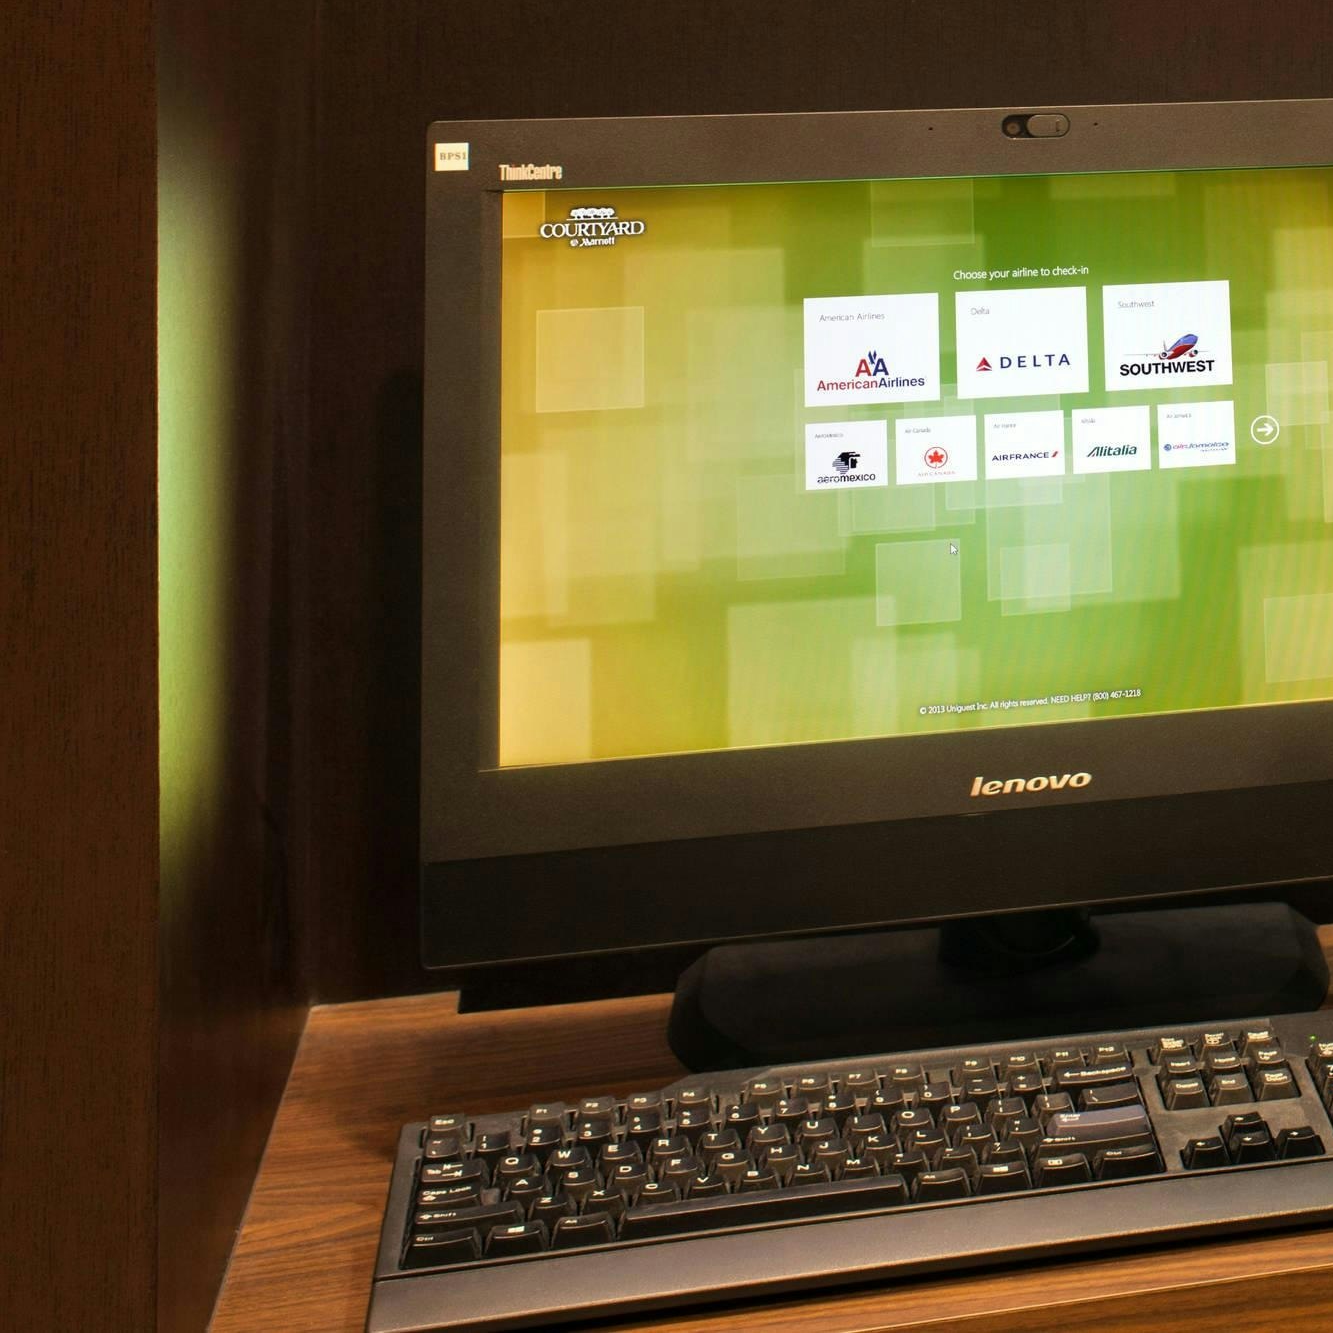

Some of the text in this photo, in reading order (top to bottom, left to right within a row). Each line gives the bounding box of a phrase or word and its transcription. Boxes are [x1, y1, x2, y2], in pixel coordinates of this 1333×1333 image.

[439, 152, 467, 161] BPS1
[499, 164, 563, 181] ThinkCentre
[540, 220, 645, 239] COURTYARD
[579, 236, 616, 247] Marriott
[953, 265, 1089, 281] Choose your airline to check-in
[1117, 300, 1155, 309] Southwest
[970, 307, 990, 315] Delta
[819, 312, 885, 323] American Airlines
[1000, 353, 1070, 369] DELTA
[1120, 360, 1215, 376] SOUTHWEST
[1087, 444, 1137, 457] Alitalia
[817, 473, 876, 484] aeromexico
[928, 705, 945, 714] 2013
[1000, 700, 1019, 709] rights
[1050, 695, 1069, 704] NEED
[1070, 693, 1091, 703] HELP?
[1092, 691, 1109, 702] (800)
[1110, 689, 1142, 698] 467-1218
[970, 772, 1092, 797] lenovo
[950, 1105, 960, 1113] P
[901, 1111, 915, 1119] O
[806, 1121, 819, 1129] U
[707, 1133, 718, 1141] T
[916, 1130, 927, 1138] L
[867, 1135, 879, 1143] K
[607, 1144, 619, 1152] E
[819, 1141, 829, 1149] J
[558, 1150, 571, 1158] W
[619, 1165, 632, 1173] D
[539, 1196, 552, 1204] Z
